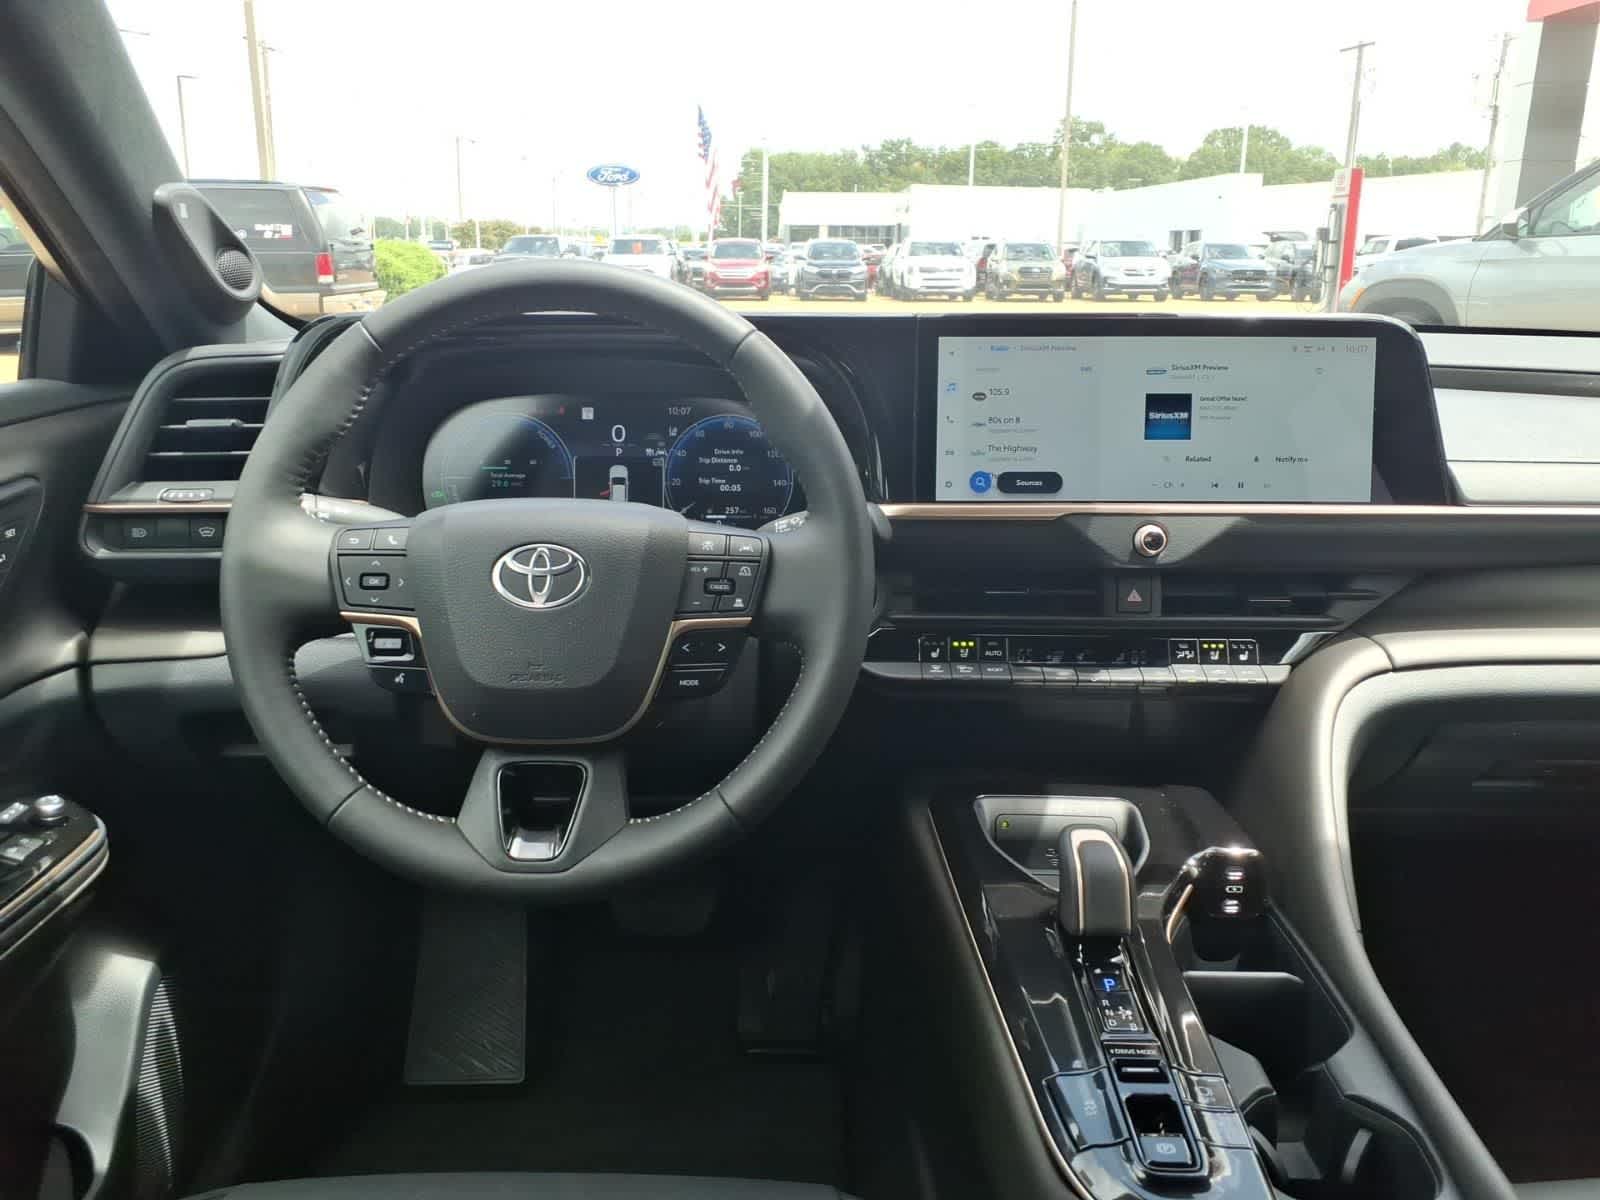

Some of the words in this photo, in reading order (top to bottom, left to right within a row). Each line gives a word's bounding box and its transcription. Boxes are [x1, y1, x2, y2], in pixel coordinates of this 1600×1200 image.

[597, 168, 630, 183] Ford
[1345, 343, 1368, 352] 10:07
[1171, 363, 1200, 371] SiriusXM
[1202, 363, 1229, 371] Preview
[989, 387, 1009, 396] 105.9
[668, 407, 692, 416] 10:07
[1148, 411, 1189, 420] SiriusXM
[611, 424, 626, 442] 0
[615, 447, 623, 457] P
[988, 445, 1001, 453] The
[1003, 445, 1038, 455] Highway
[698, 456, 710, 464] Trip
[1275, 456, 1296, 464] Notify
[728, 464, 742, 472] 0.0
[773, 479, 787, 487] 140
[719, 484, 742, 492] 00:05
[725, 506, 740, 514] 257
[763, 506, 777, 514] 160
[679, 679, 699, 687] MODE
[1103, 978, 1116, 992] P
[1101, 999, 1110, 1007] R
[1108, 1019, 1118, 1027] D
[1115, 1047, 1136, 1055] DRIVE
[1136, 1047, 1158, 1055] MODE
